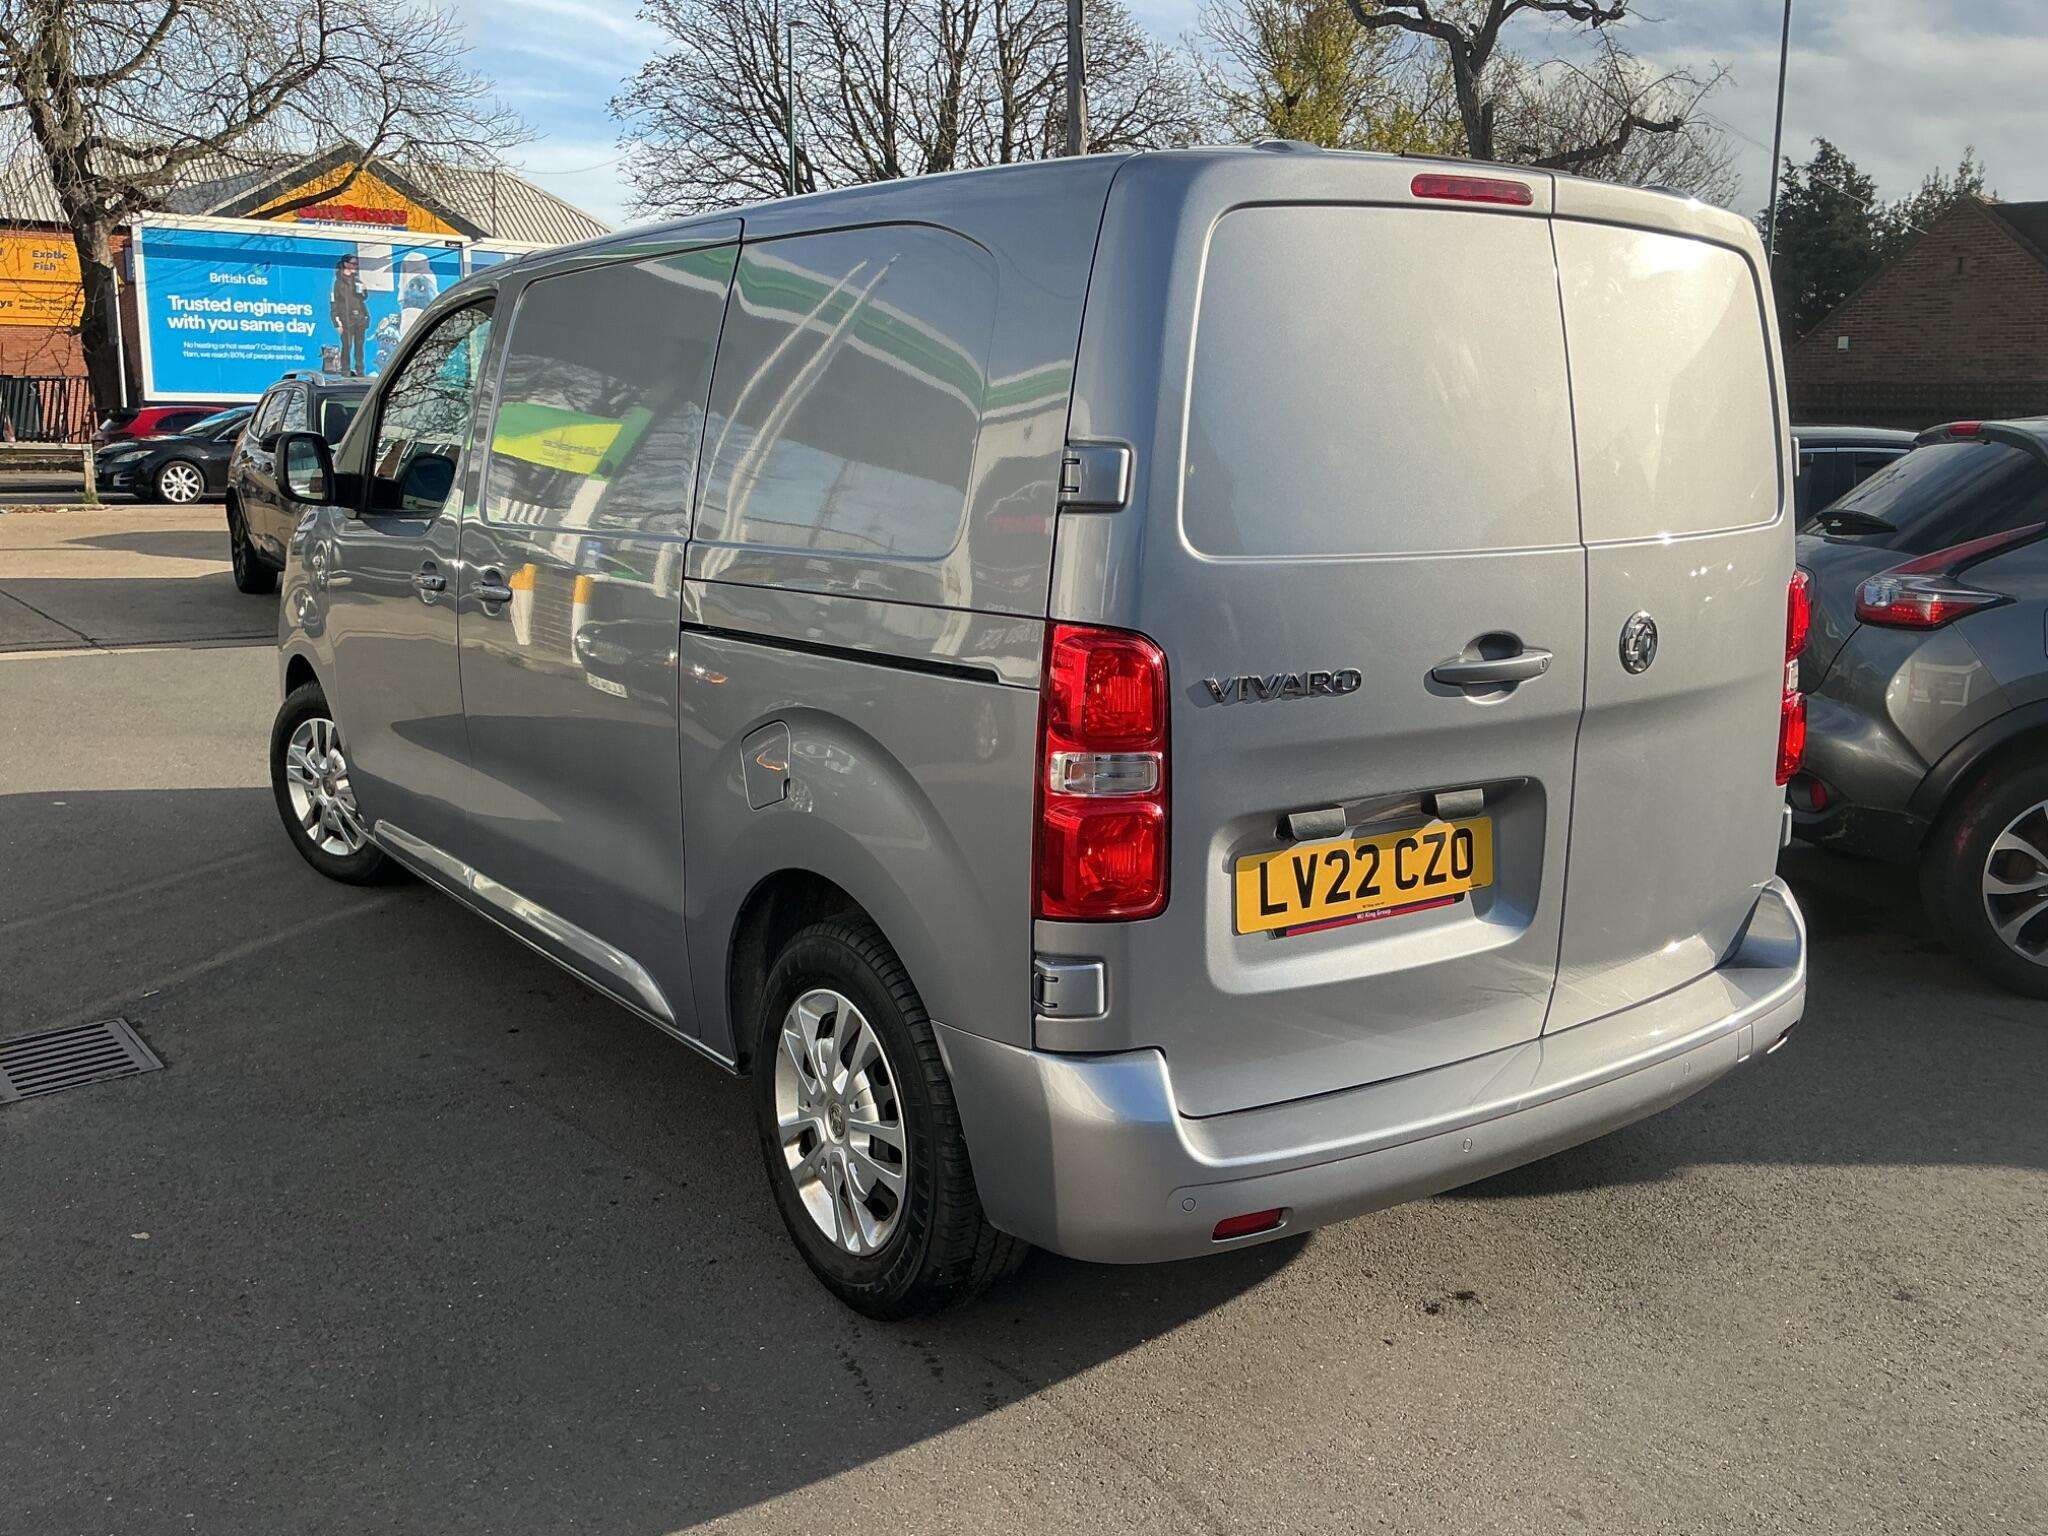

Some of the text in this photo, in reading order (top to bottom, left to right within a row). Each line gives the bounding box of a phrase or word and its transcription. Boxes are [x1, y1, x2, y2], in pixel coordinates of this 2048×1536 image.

[32, 249, 68, 260] Exotic
[33, 261, 57, 271] Fish
[209, 272, 268, 286] British Gas
[167, 295, 313, 317] Trusted engineers
[167, 314, 316, 337] with you same day
[183, 341, 193, 349] No
[193, 341, 218, 350] heating
[238, 343, 260, 351] water?
[261, 343, 286, 351] Contact
[294, 344, 303, 353] by
[253, 353, 275, 361] people
[1203, 667, 1362, 703] VIVARO
[1259, 828, 1474, 916] LV22 CZO
[1365, 910, 1377, 918] King
[1377, 908, 1392, 916] Group
